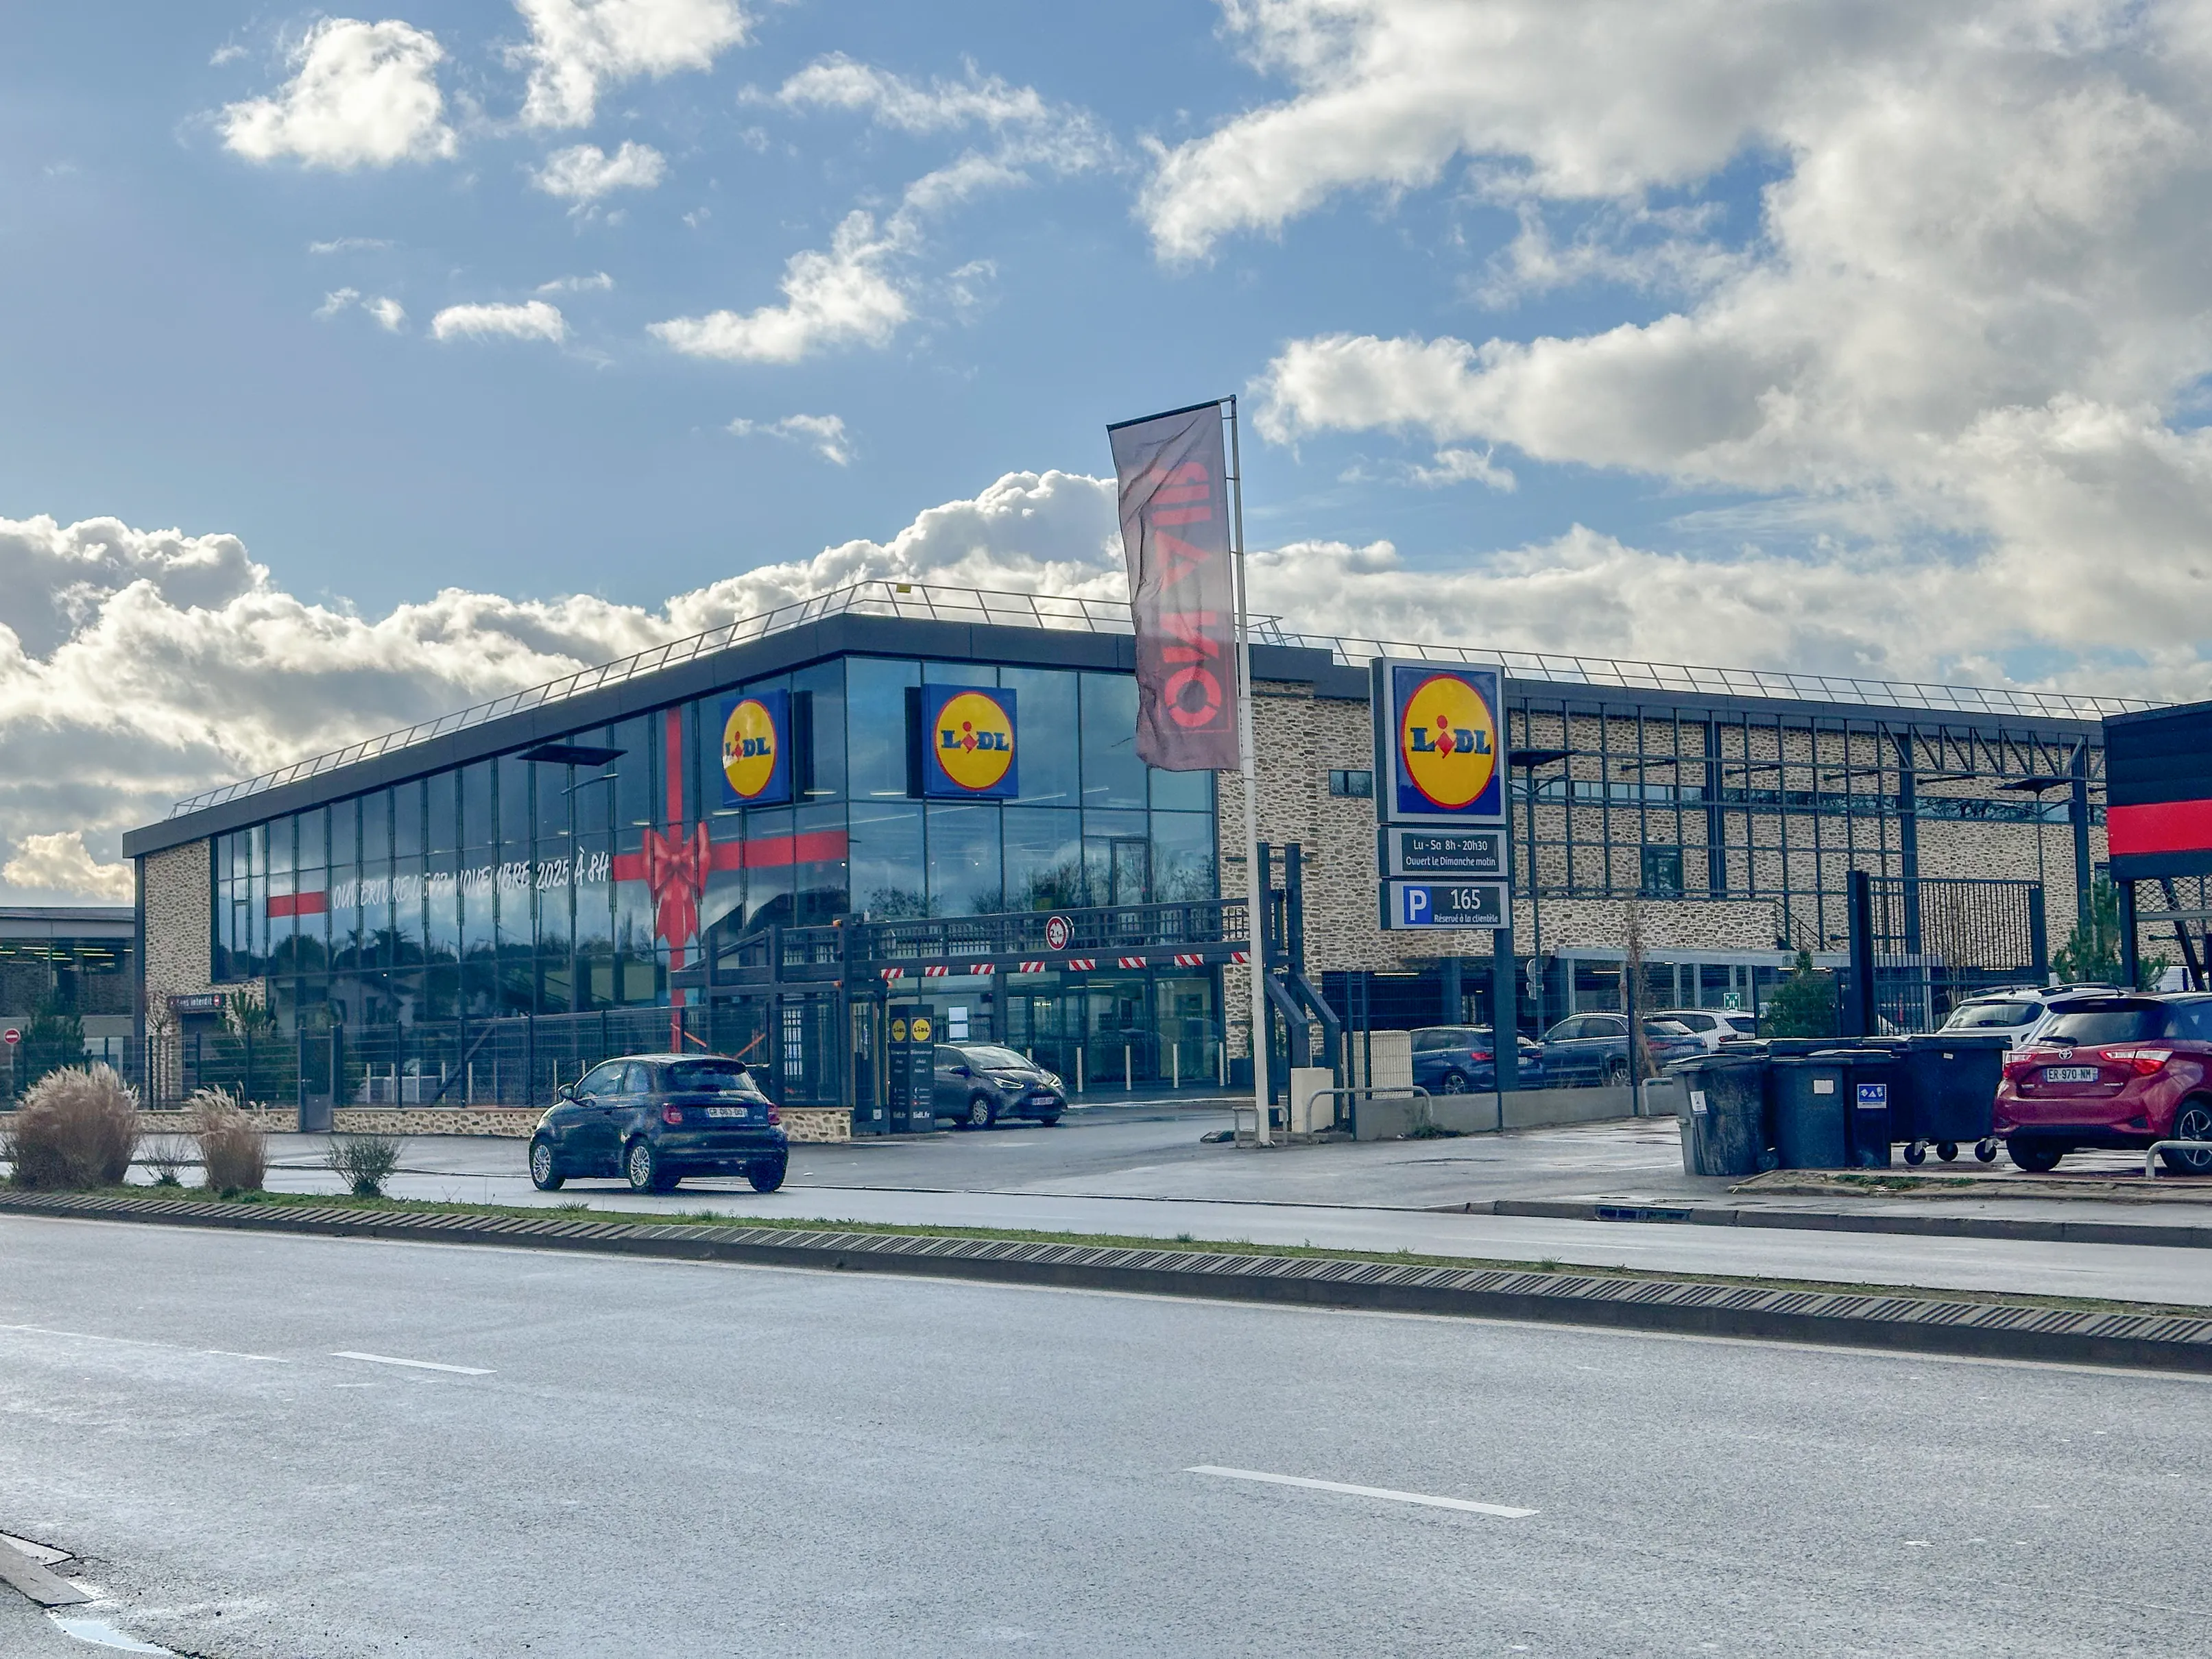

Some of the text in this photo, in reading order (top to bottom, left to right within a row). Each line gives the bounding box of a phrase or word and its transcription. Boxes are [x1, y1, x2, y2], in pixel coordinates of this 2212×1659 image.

[1413, 840, 1423, 850] Lu
[1431, 840, 1441, 850] Sa
[1445, 840, 1456, 851] 8h
[1463, 840, 1488, 851] 20h30
[1406, 856, 1496, 866] Ouvert le Dimanche matin
[536, 859, 569, 890] 2025
[588, 851, 610, 883] 8H
[1409, 889, 1480, 921] P 165
[1434, 914, 1498, 923] Réservé à la clientèle
